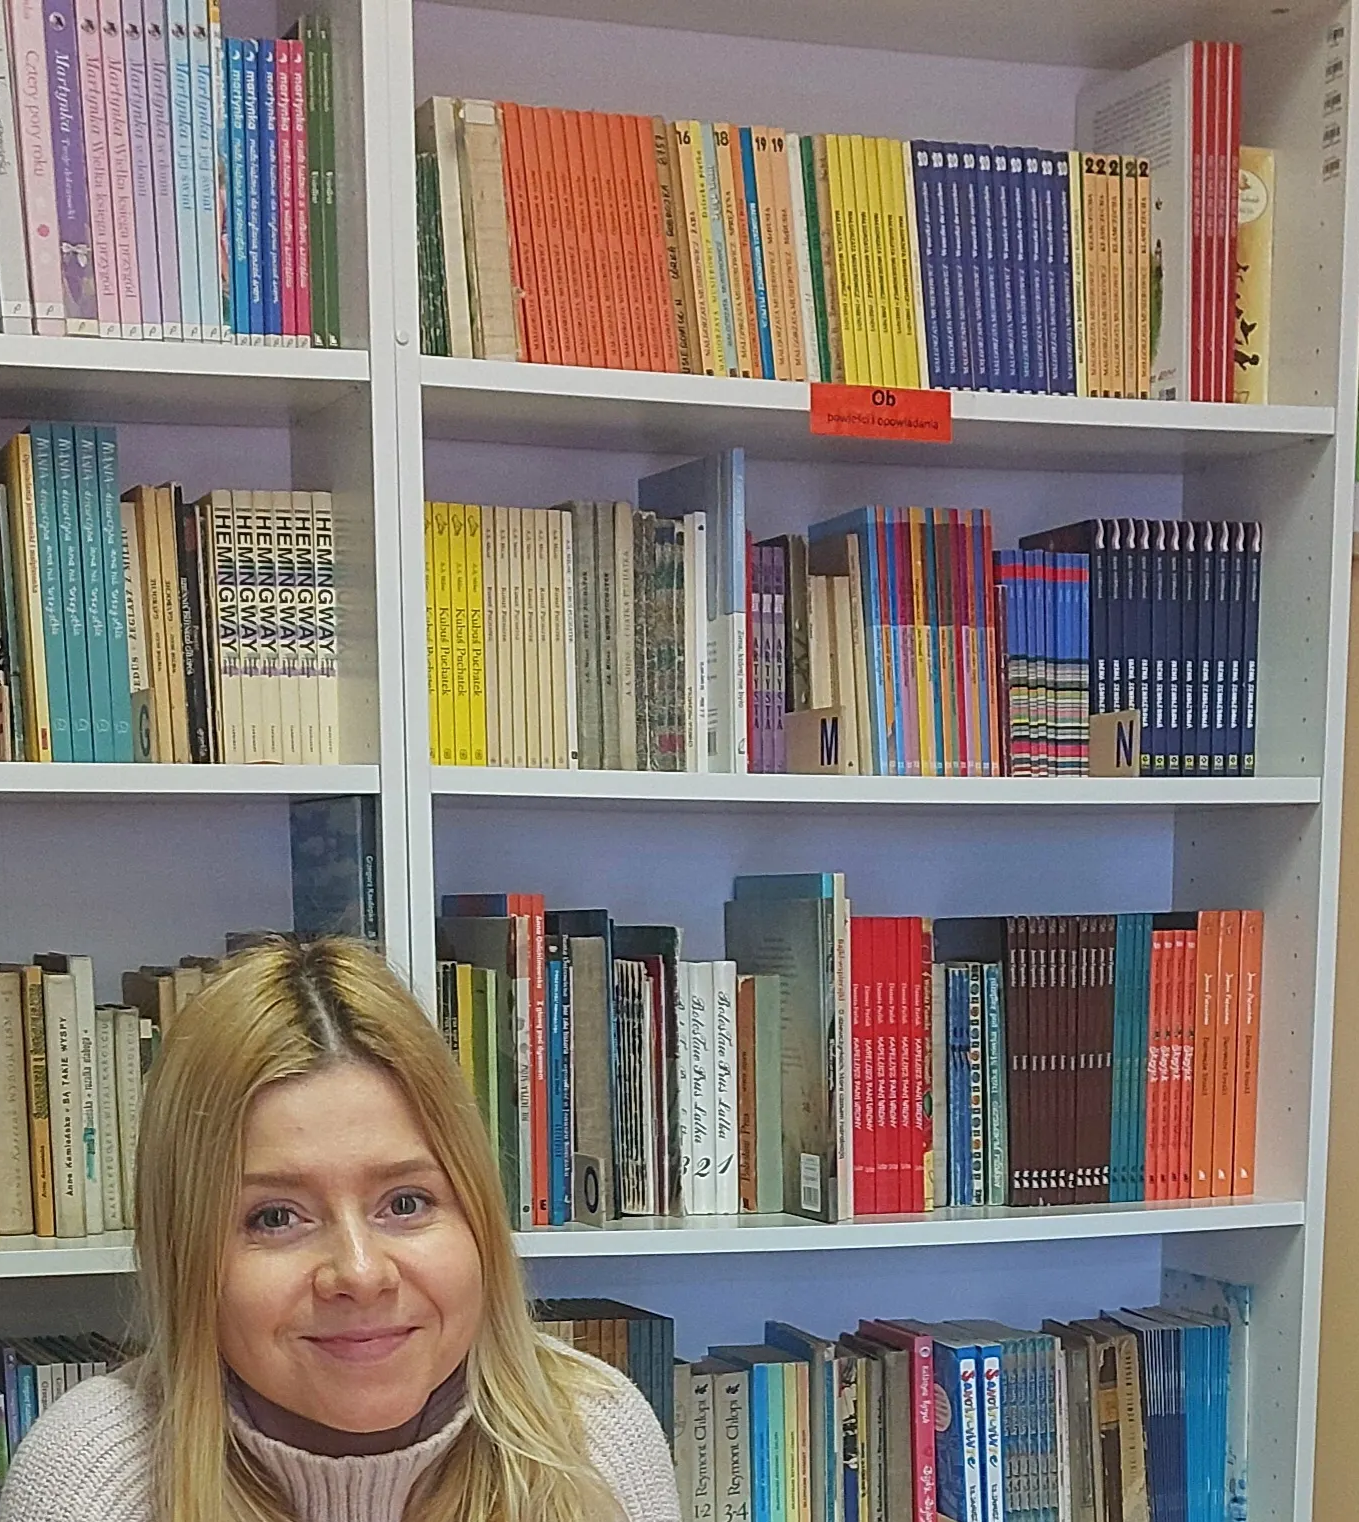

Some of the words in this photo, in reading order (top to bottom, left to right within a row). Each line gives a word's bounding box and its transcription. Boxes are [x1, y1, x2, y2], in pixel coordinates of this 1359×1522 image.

[24, 50, 39, 99] Cztery
[54, 50, 73, 133] Martynka
[25, 105, 42, 139] pory
[246, 70, 257, 130] martynka
[278, 71, 290, 131] martynka
[293, 72, 304, 131] martynka
[33, 144, 47, 176] roku
[676, 131, 691, 146] 16
[715, 131, 730, 147] 18
[755, 137, 767, 152] 19
[771, 137, 784, 153] 19
[872, 390, 895, 406] Ob
[215, 516, 238, 651] HEMINGWAY
[236, 516, 258, 653] HEMINGWAY
[256, 516, 276, 653] HEMINGWAY
[276, 517, 296, 653] HEMINGWAY
[296, 517, 315, 653] HEMINGWAY
[456, 608, 466, 644] Kubuś
[471, 609, 481, 644] Kubuś
[457, 647, 467, 696] Puchatek
[472, 648, 482, 696] Puchatek
[821, 717, 839, 766] M
[1116, 719, 1135, 768] N
[59, 1016, 67, 1052] WYSPY
[691, 995, 708, 1061] Bolesław
[718, 991, 733, 1057] Bolesław
[60, 1057, 69, 1086] TAKIE
[692, 1064, 706, 1097] Prus
[718, 1060, 732, 1093] Prus
[693, 1102, 707, 1143] Lalka
[718, 1097, 731, 1139] Lalka
[693, 1399, 712, 1442] Chłopi
[726, 1399, 742, 1442] Chłopi
[695, 1448, 711, 1498] Reymont
[726, 1448, 742, 1497] Reymont
[694, 1503, 712, 1518] 1-2
